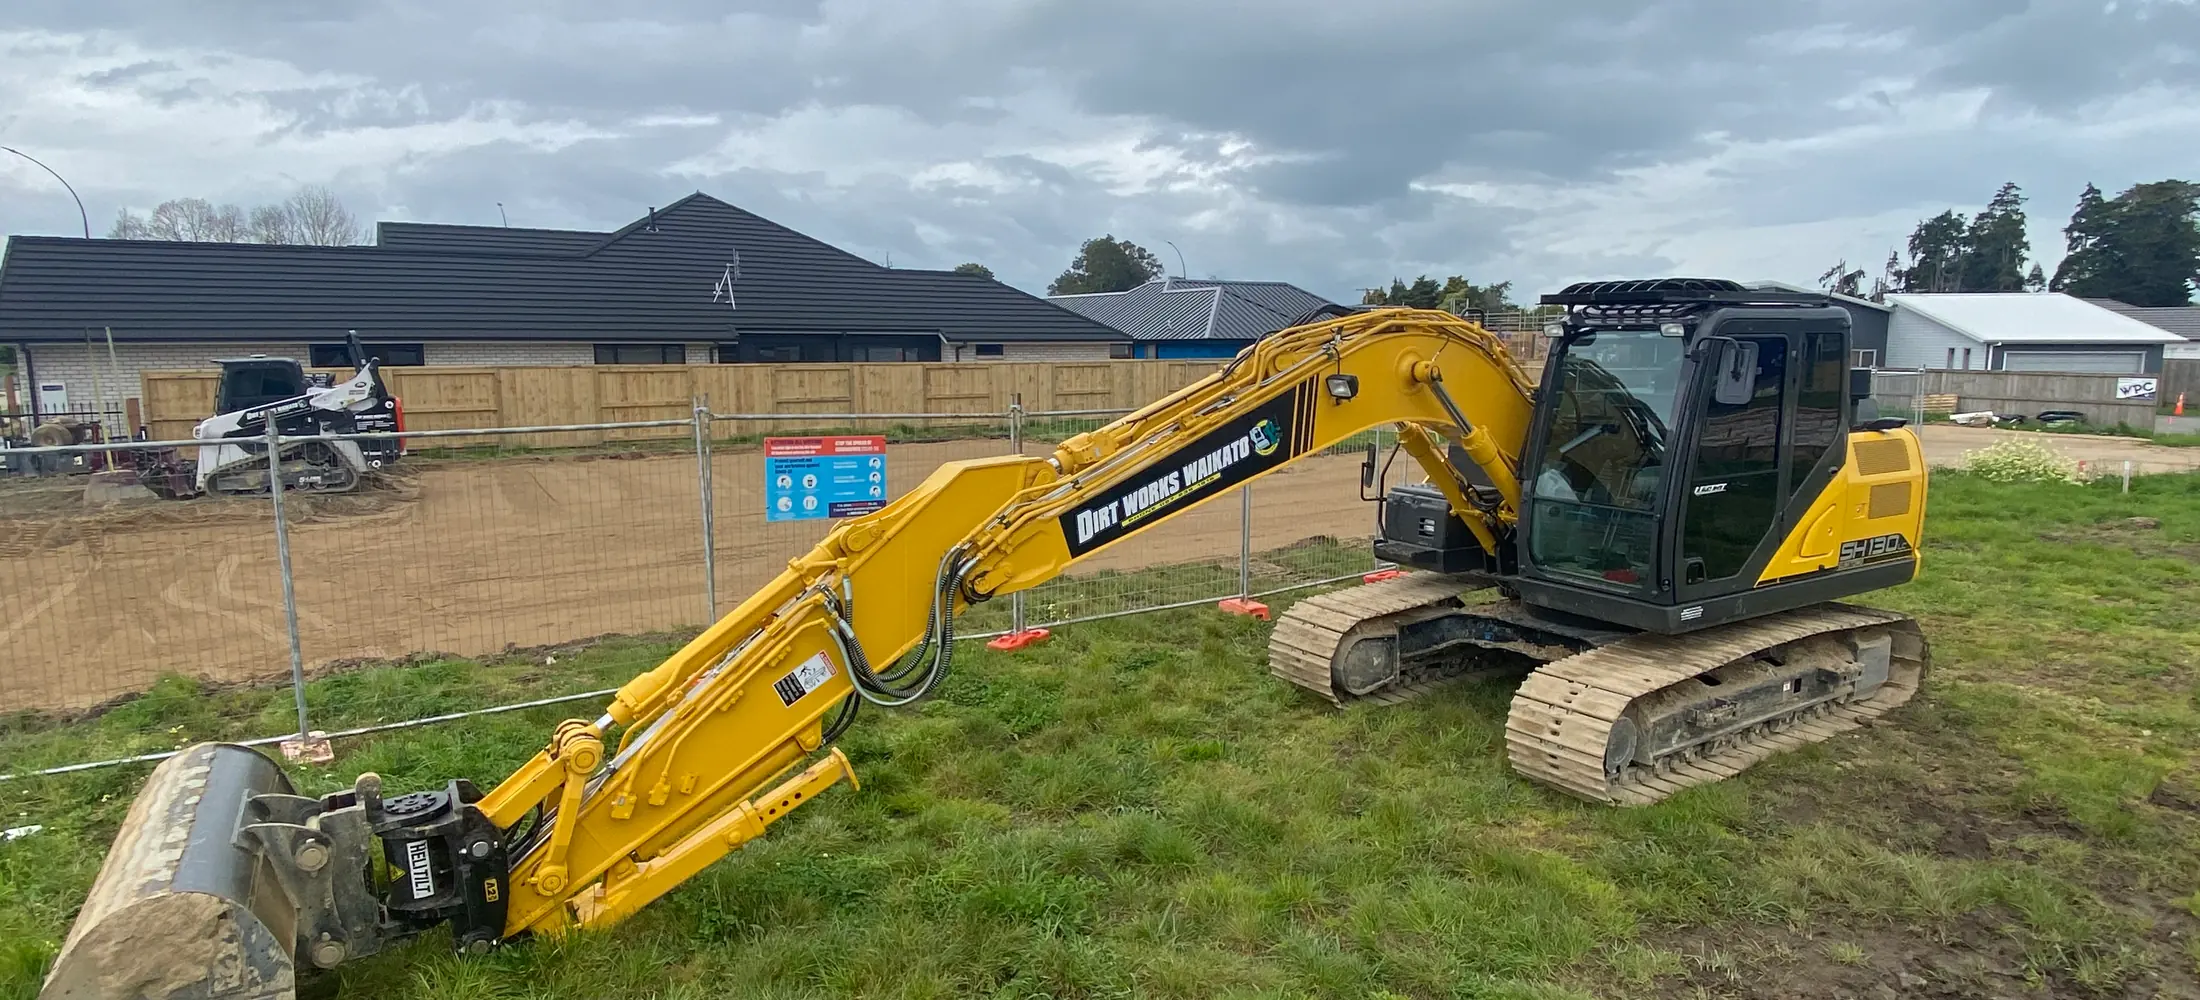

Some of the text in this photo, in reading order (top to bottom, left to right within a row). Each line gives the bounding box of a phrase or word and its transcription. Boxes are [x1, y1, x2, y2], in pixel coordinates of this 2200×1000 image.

[2119, 382, 2154, 396] WPC
[1076, 436, 1250, 544] DIRT WORKS WAIKATO
[410, 843, 431, 893] HELITILT
